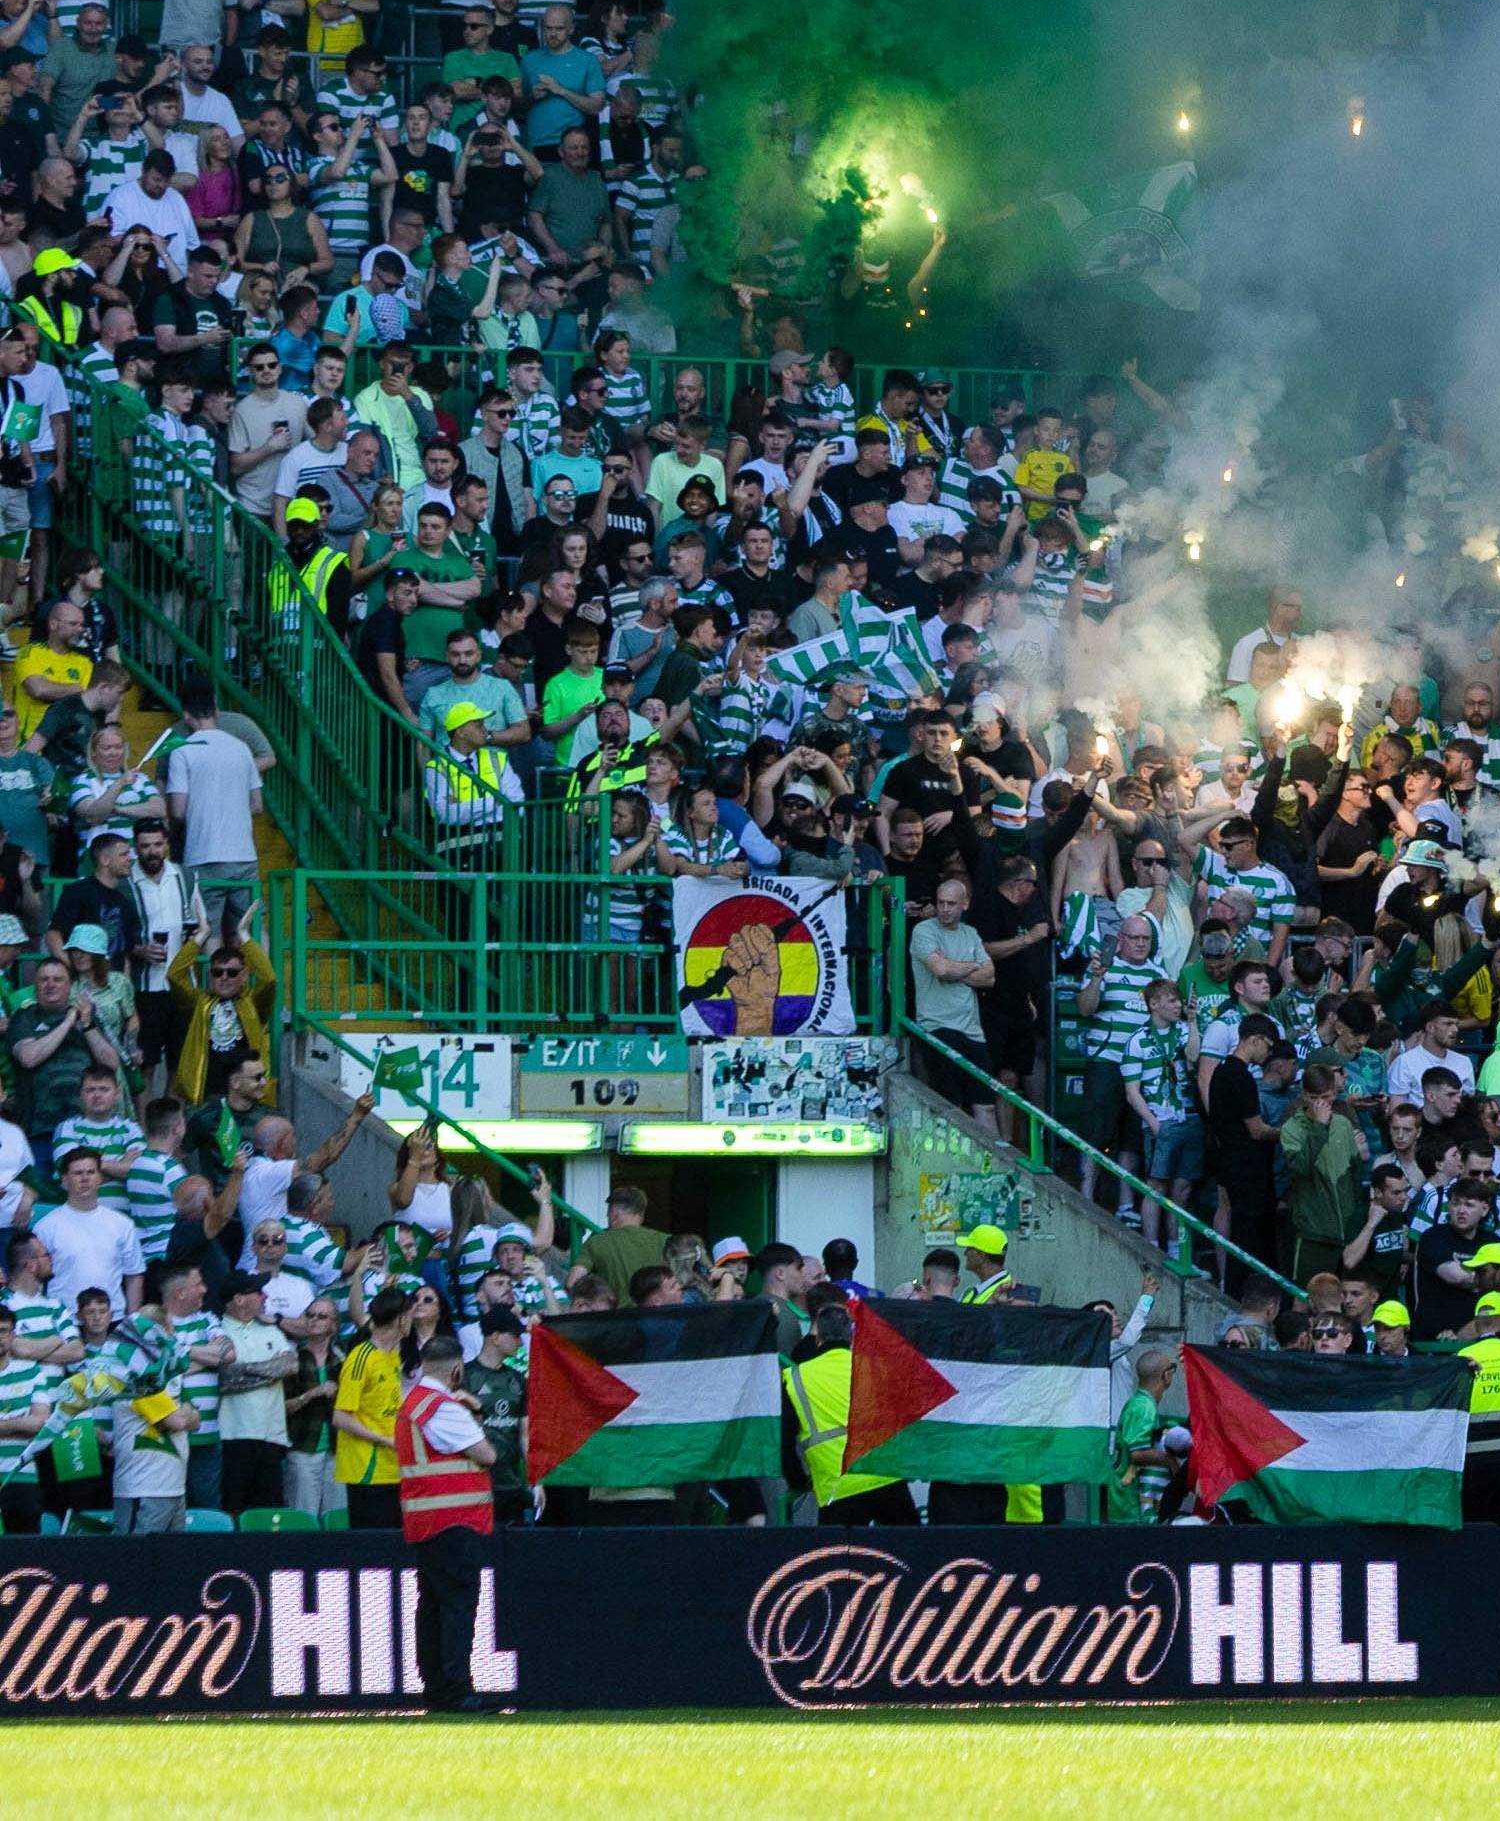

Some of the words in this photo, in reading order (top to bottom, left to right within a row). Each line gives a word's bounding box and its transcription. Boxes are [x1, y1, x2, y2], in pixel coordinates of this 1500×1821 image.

[742, 876, 800, 906] BRIGADA
[807, 912, 838, 1032] INTERNACIONAL
[570, 1079, 640, 1107] 109
[1482, 1384, 1500, 1395] 176
[748, 1543, 1182, 1710] William
[1189, 1561, 1419, 1684] HILL
